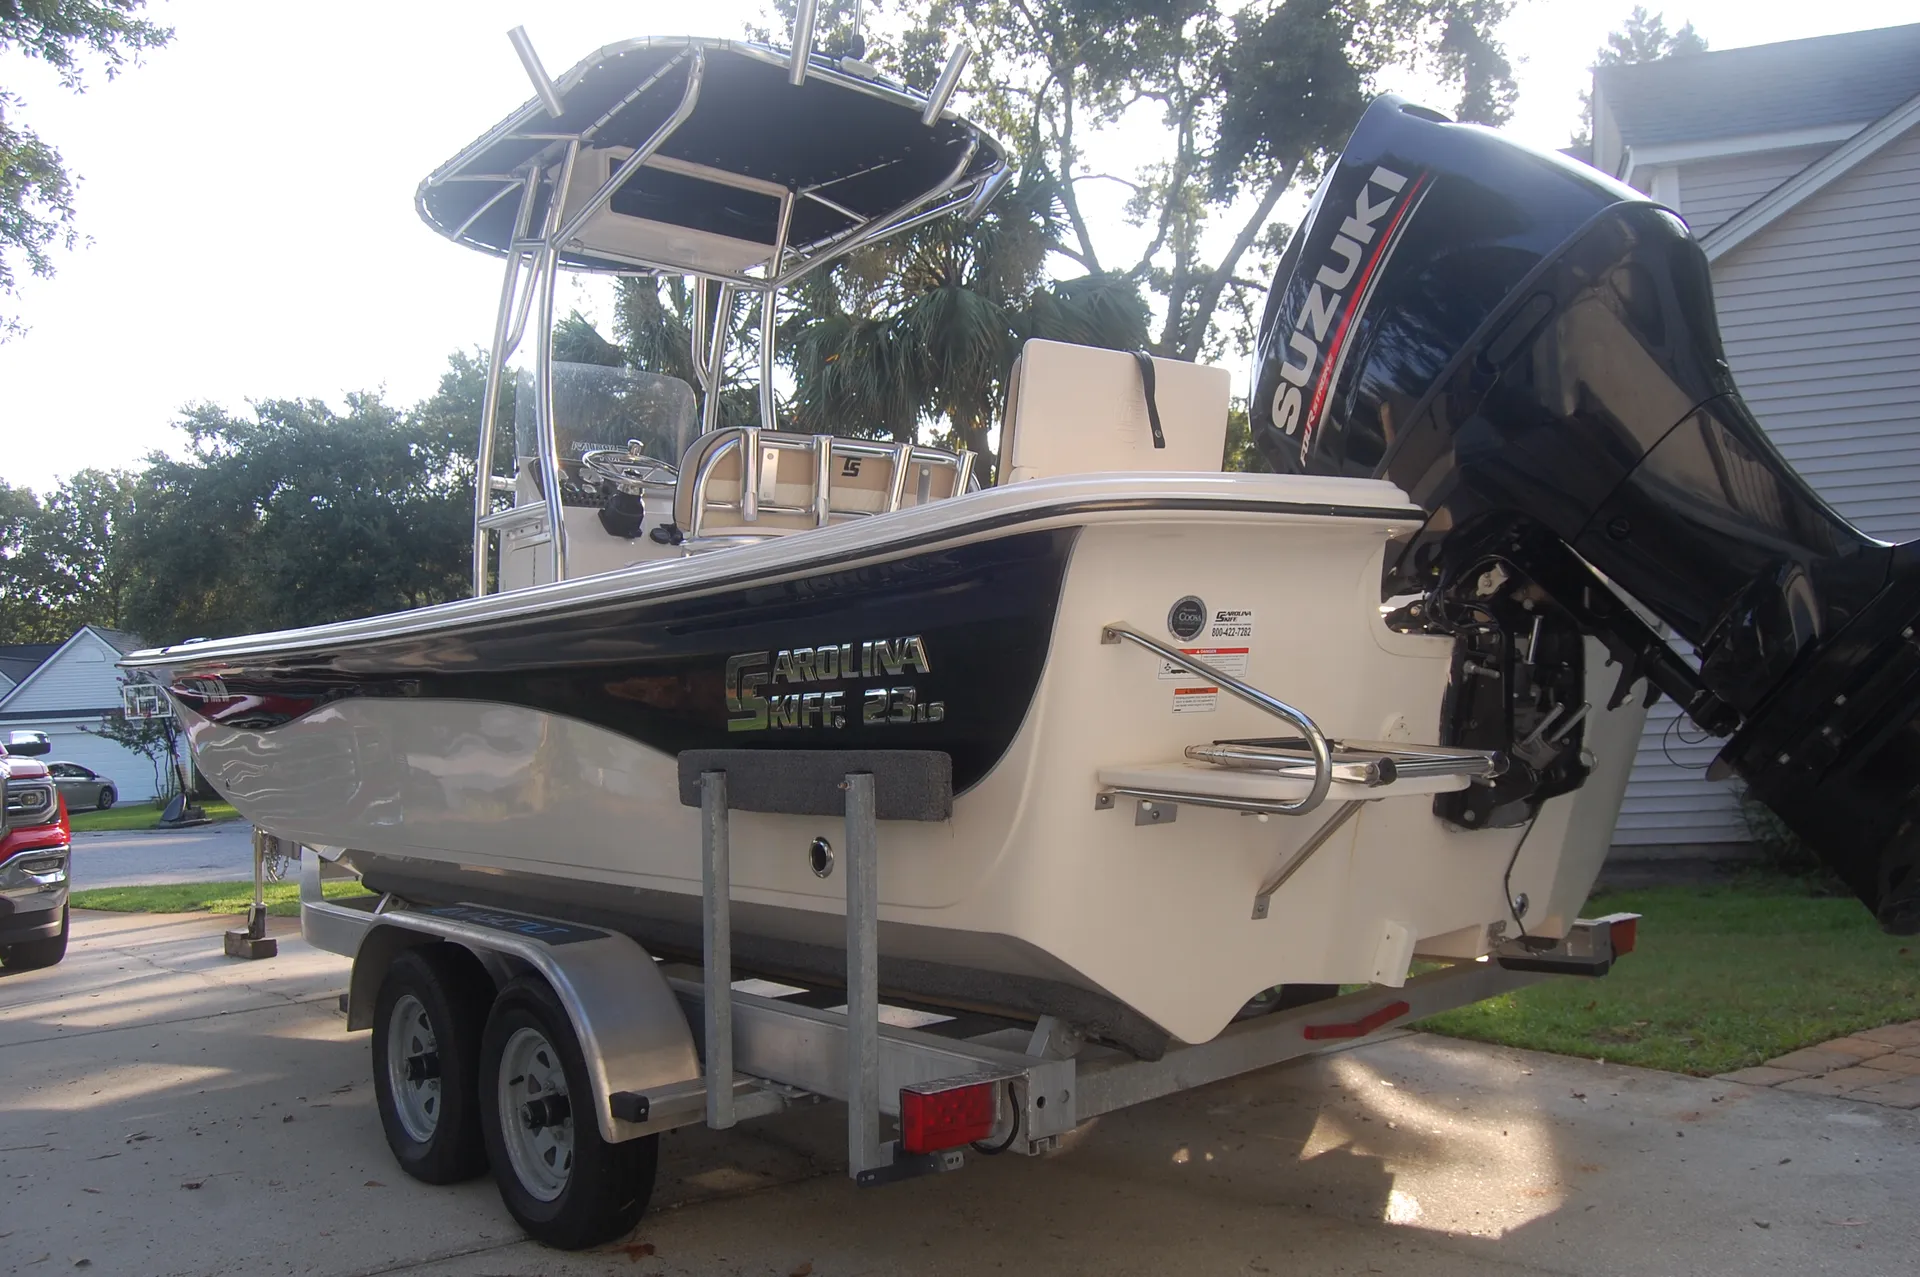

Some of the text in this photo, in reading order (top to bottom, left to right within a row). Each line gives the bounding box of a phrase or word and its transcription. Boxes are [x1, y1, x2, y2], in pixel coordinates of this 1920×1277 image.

[1272, 165, 1408, 436] SUZUKI
[1300, 352, 1334, 468] FOUR STROKE
[1212, 627, 1251, 637] 800-422-7282
[726, 635, 931, 712] CAROLINA
[728, 672, 846, 732] SKIFF
